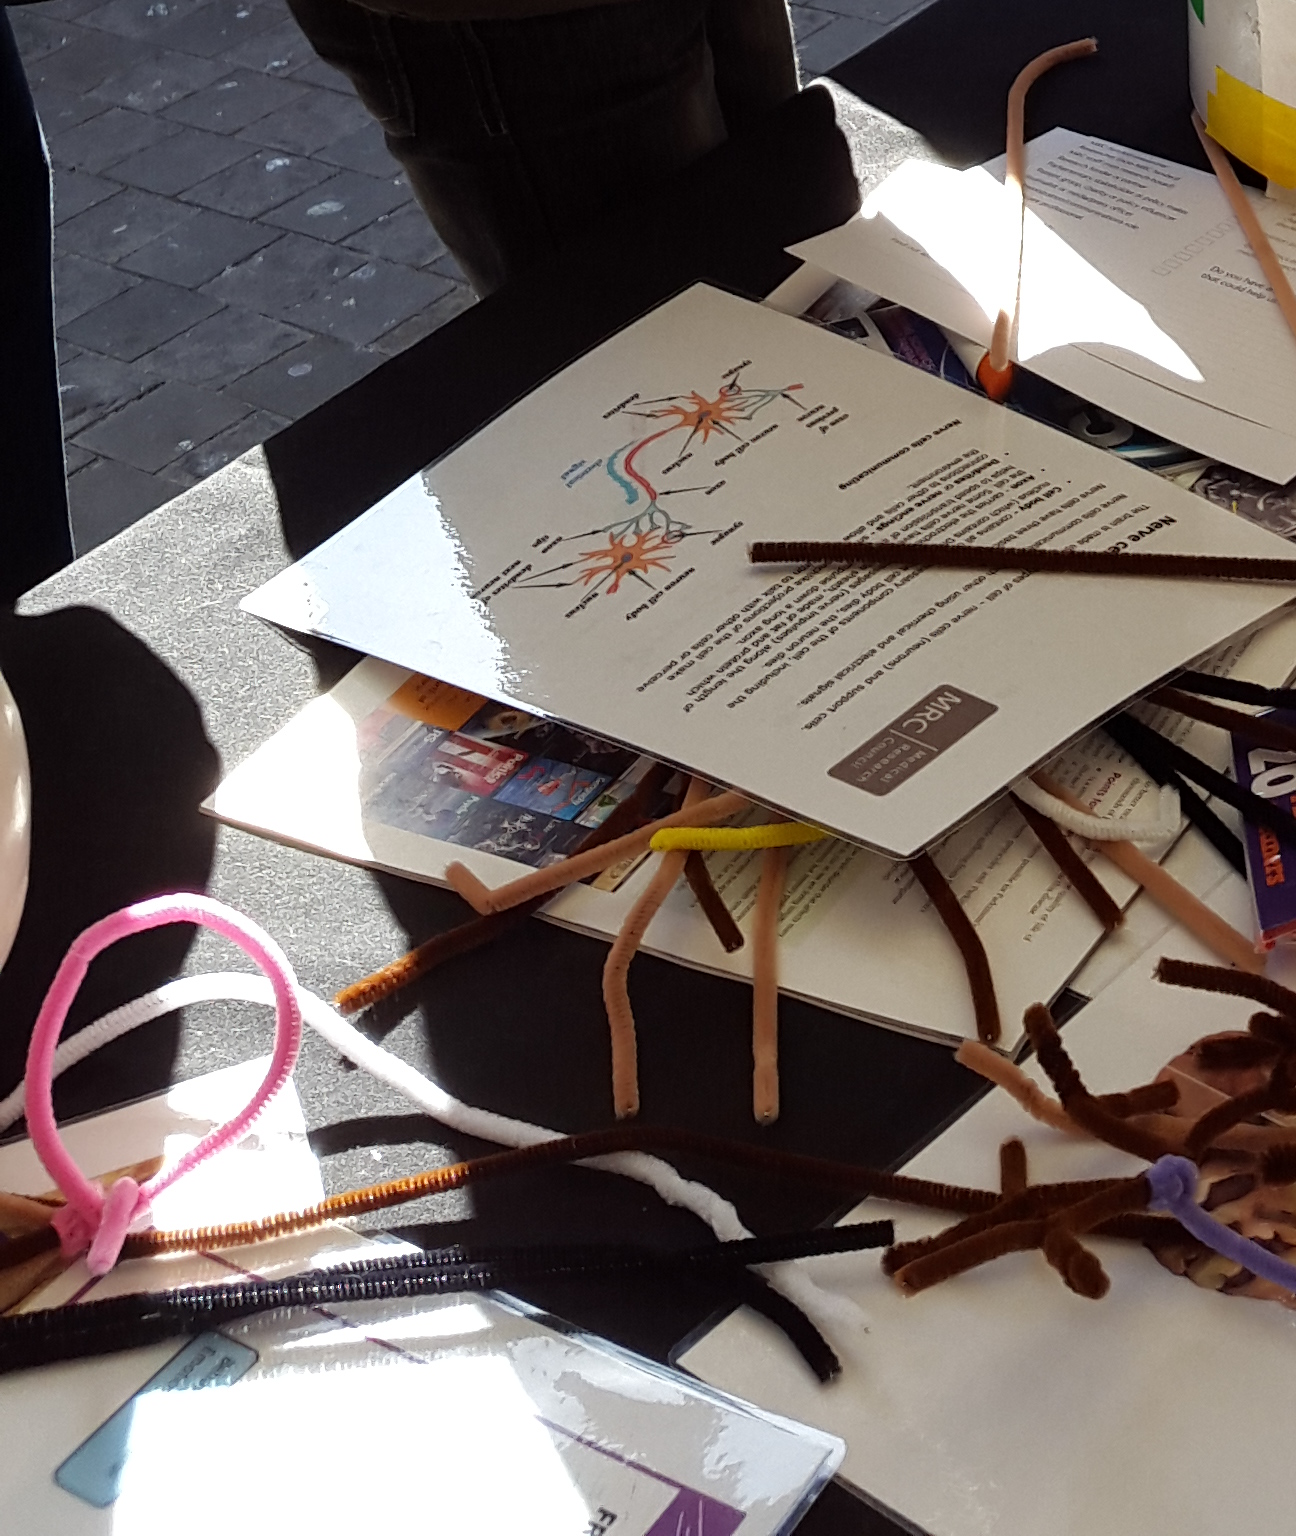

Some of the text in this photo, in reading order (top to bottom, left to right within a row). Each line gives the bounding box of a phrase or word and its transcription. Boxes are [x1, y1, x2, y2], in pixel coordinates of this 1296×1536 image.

[839, 419, 961, 489] Nerve cells communicating
[953, 458, 999, 484] Dendrites
[1010, 474, 1034, 488] Axon
[914, 490, 942, 507] nerve
[1042, 486, 1061, 498] Cell
[1018, 496, 1044, 510] body
[876, 507, 914, 530] endings
[1127, 515, 1176, 541] Nerve
[625, 567, 694, 620] neuron cell body
[793, 585, 818, 603] down
[817, 588, 850, 610] (nerve
[934, 591, 961, 607] using
[740, 597, 761, 612] with
[742, 585, 794, 622] projections
[796, 594, 823, 612] made
[838, 588, 893, 625] components
[761, 610, 786, 625] long
[785, 613, 797, 621] of
[819, 614, 837, 626] the
[896, 607, 936, 635] chemical
[950, 605, 977, 622] nerve
[715, 613, 740, 633] other
[732, 623, 742, 633] of
[769, 621, 786, 632] fat
[771, 611, 819, 643] impulses)
[828, 625, 838, 634] of
[929, 622, 950, 637] cells
[690, 633, 713, 649] cells
[714, 632, 732, 645] the
[735, 625, 762, 644] axon.
[751, 632, 770, 647] and
[785, 626, 819, 651] neuron
[809, 634, 828, 646] the
[877, 634, 896, 649] and
[680, 651, 690, 660] or
[695, 646, 713, 659] cell
[715, 646, 750, 672] protein
[743, 644, 771, 664] along
[882, 637, 930, 669] (neurons)
[666, 659, 695, 680] make
[726, 665, 745, 677] the
[834, 648, 876, 679] electrical
[636, 660, 677, 691] perceive
[686, 674, 715, 695] which
[744, 662, 790, 694] including
[864, 669, 883, 684] and
[694, 678, 727, 702] length
[797, 680, 834, 705] signals.
[826, 684, 864, 712] support
[682, 702, 693, 712] of
[727, 695, 746, 708] the
[801, 712, 826, 729] cells.
[902, 692, 960, 732] MRC
[484, 751, 524, 786] Politics
[856, 743, 910, 781] Research
[880, 750, 925, 782] Medical
